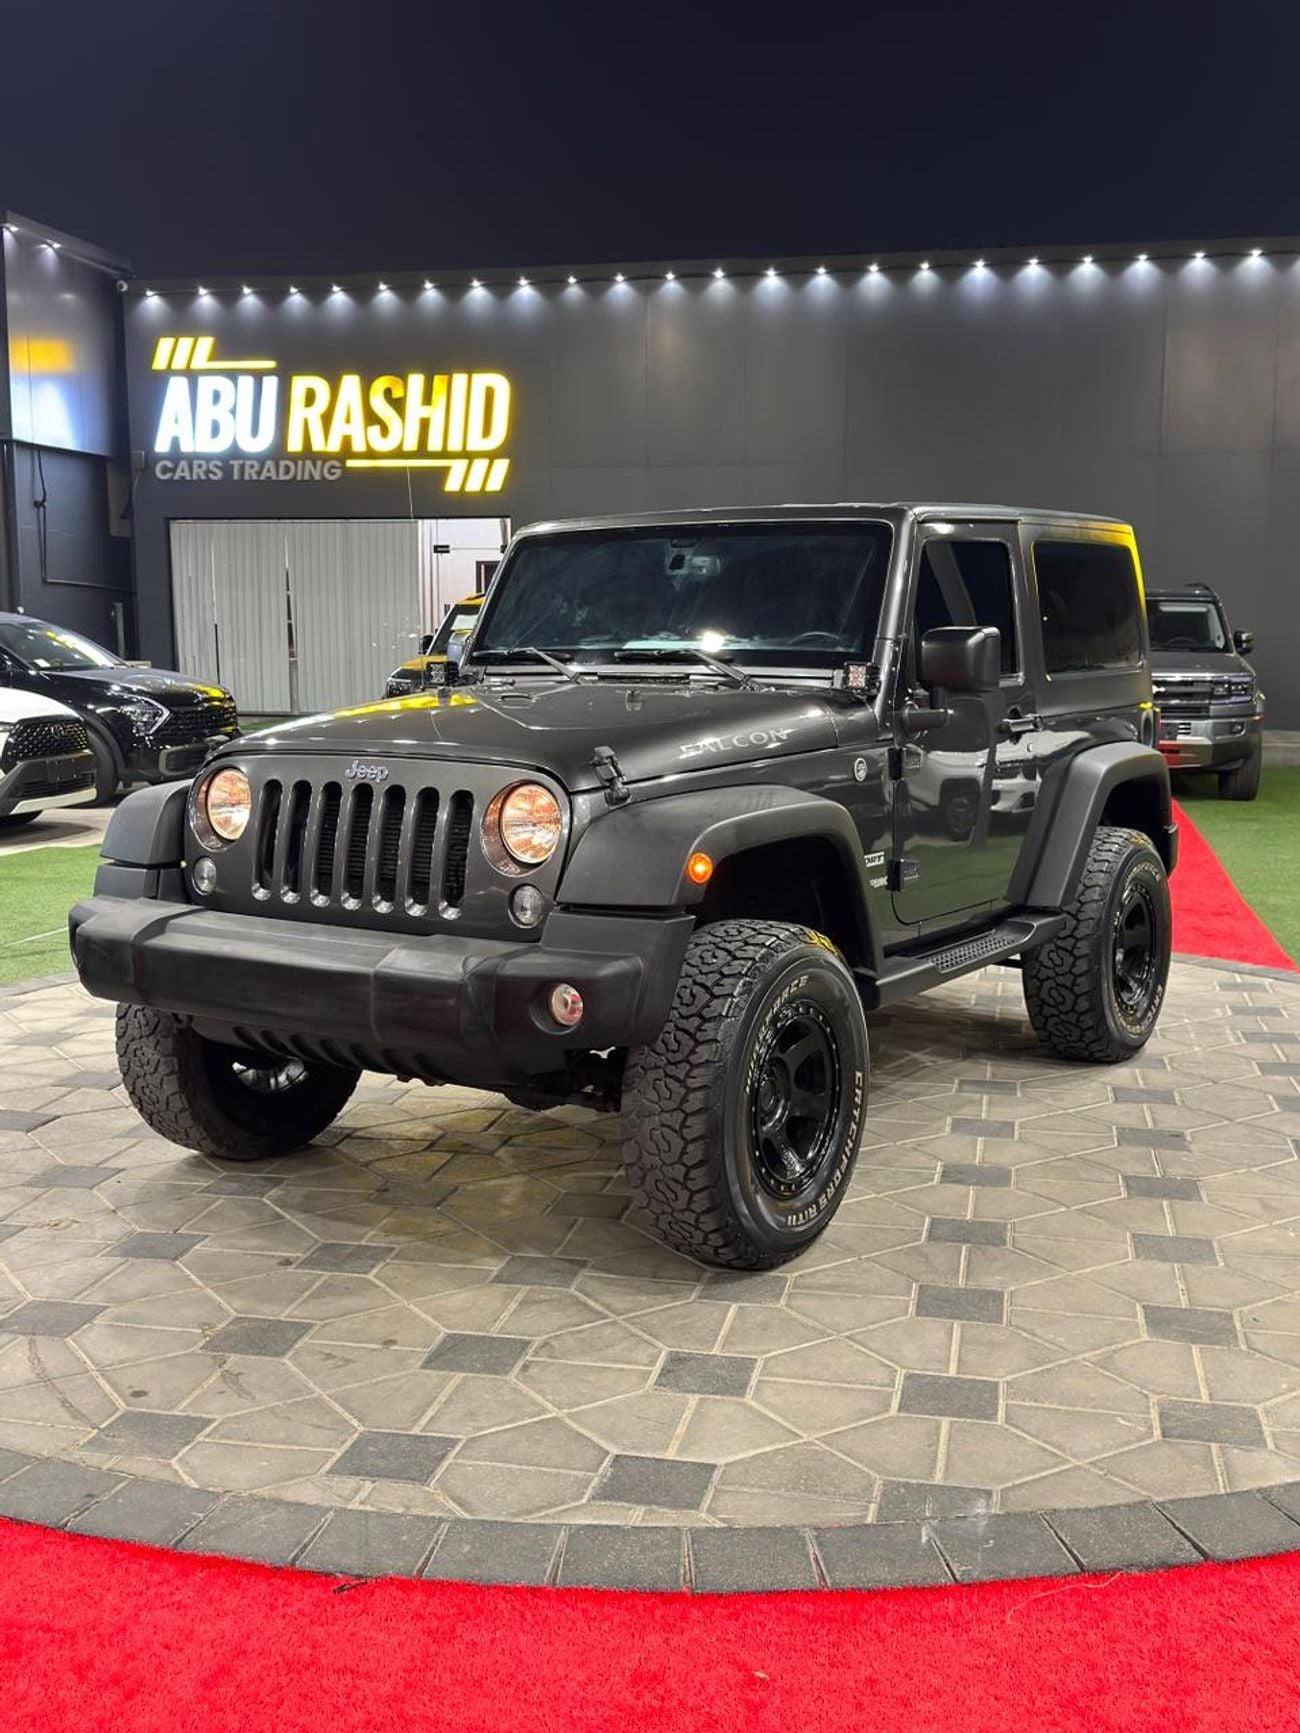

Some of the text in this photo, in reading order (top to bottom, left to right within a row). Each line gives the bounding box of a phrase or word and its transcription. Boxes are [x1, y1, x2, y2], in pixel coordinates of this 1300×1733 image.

[154, 372, 511, 452] ABU RASHID
[155, 459, 344, 481] CARS TRADING
[345, 760, 389, 783] Jeep
